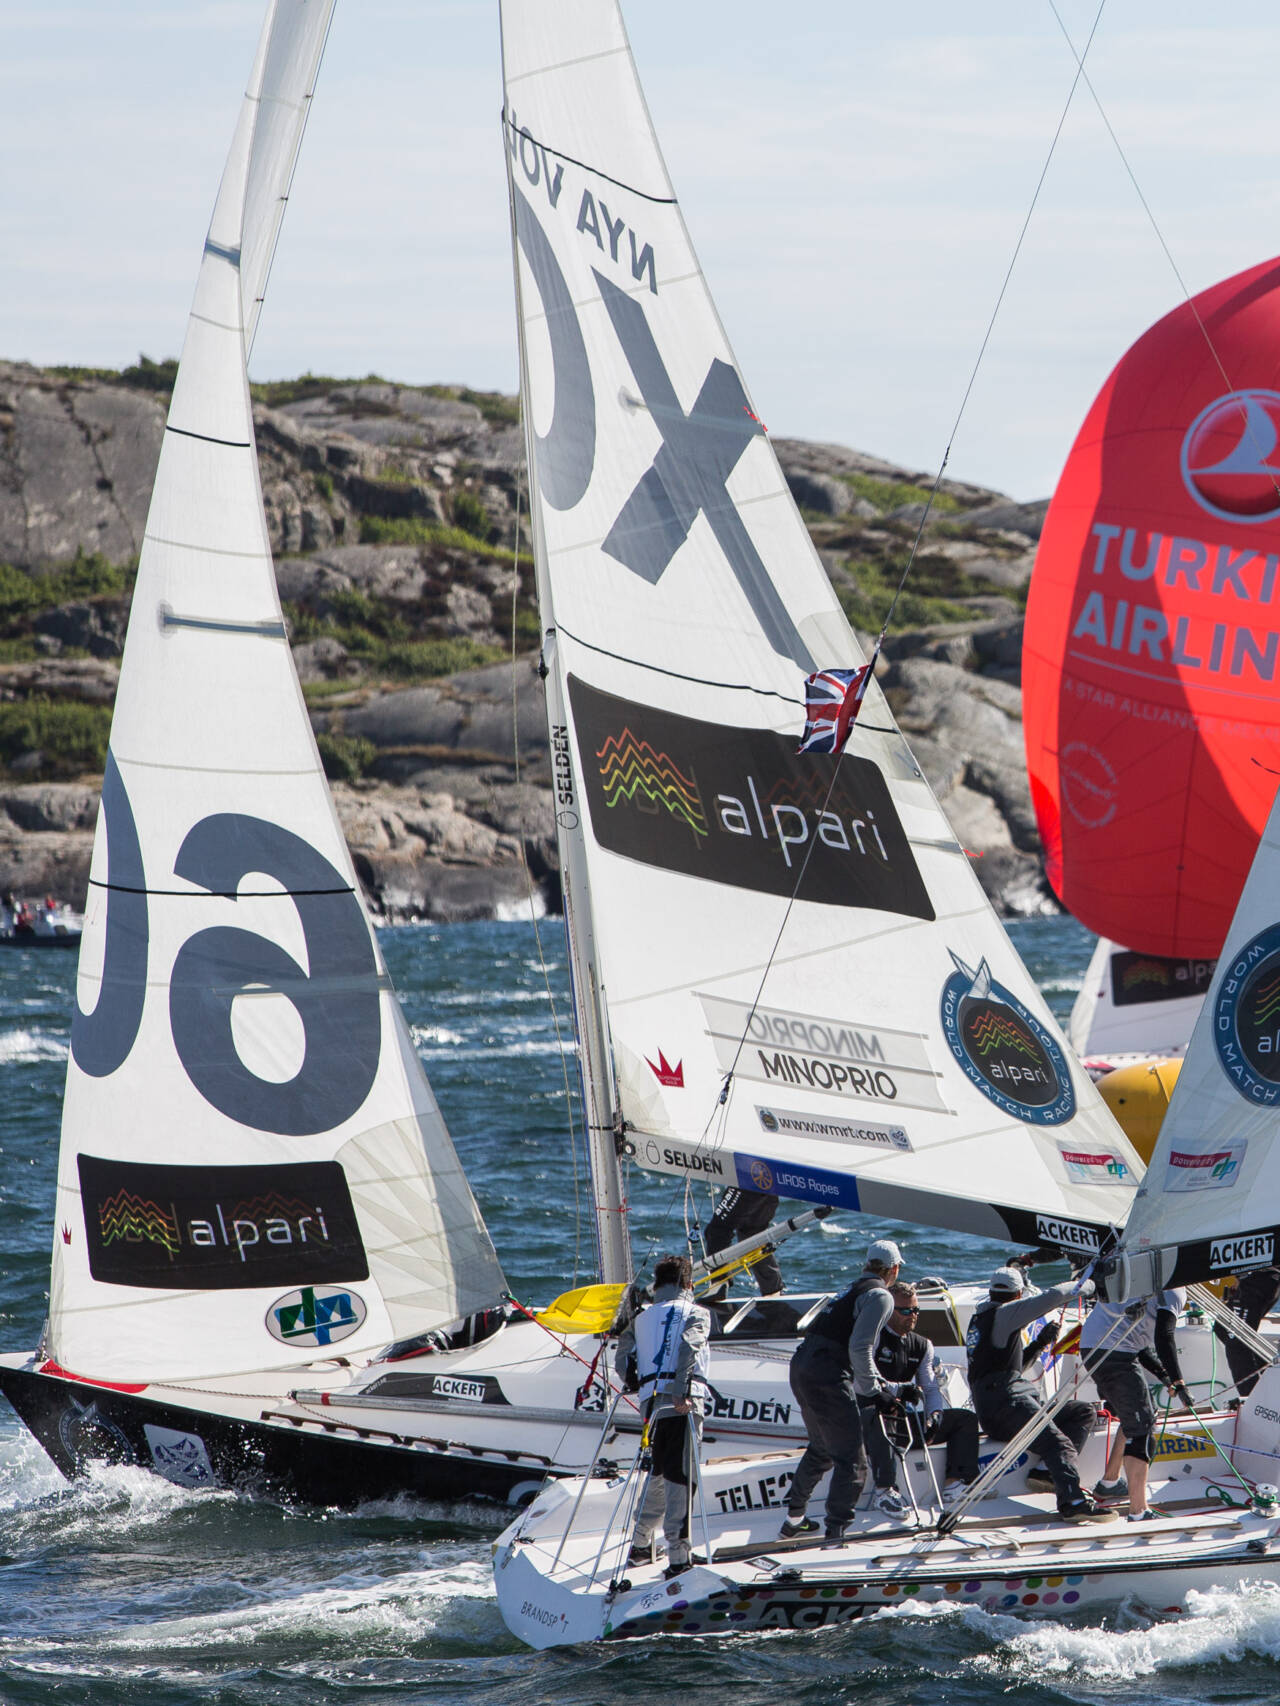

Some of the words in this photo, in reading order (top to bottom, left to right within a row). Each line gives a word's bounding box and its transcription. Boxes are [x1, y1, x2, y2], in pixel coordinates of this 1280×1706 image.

[1076, 685, 1116, 710] STAR
[1120, 700, 1219, 735] ALLIANCE
[551, 725, 574, 806] SELDÉN
[719, 775, 889, 867] alpari
[1219, 945, 1264, 1031] WORLD
[945, 989, 963, 1058] WORLD
[1016, 1004, 1060, 1064] TOUR
[757, 1050, 897, 1100] MINOPRIO
[967, 1065, 1032, 1120] MATCH
[990, 1059, 1048, 1086] alpari
[1223, 1042, 1277, 1100] MATCH
[1043, 1077, 1071, 1121] RACING
[778, 1115, 891, 1144] www.wmrt.com
[663, 1149, 723, 1175] SELDÉN
[776, 1172, 807, 1190] LIROS
[808, 1179, 840, 1196] Ropes
[191, 1204, 329, 1262] alpari
[1037, 1220, 1100, 1247] ACKERT
[1210, 1235, 1274, 1265] ACKERT
[433, 1378, 486, 1398] ACKERT
[702, 1397, 791, 1424] SELDÉN
